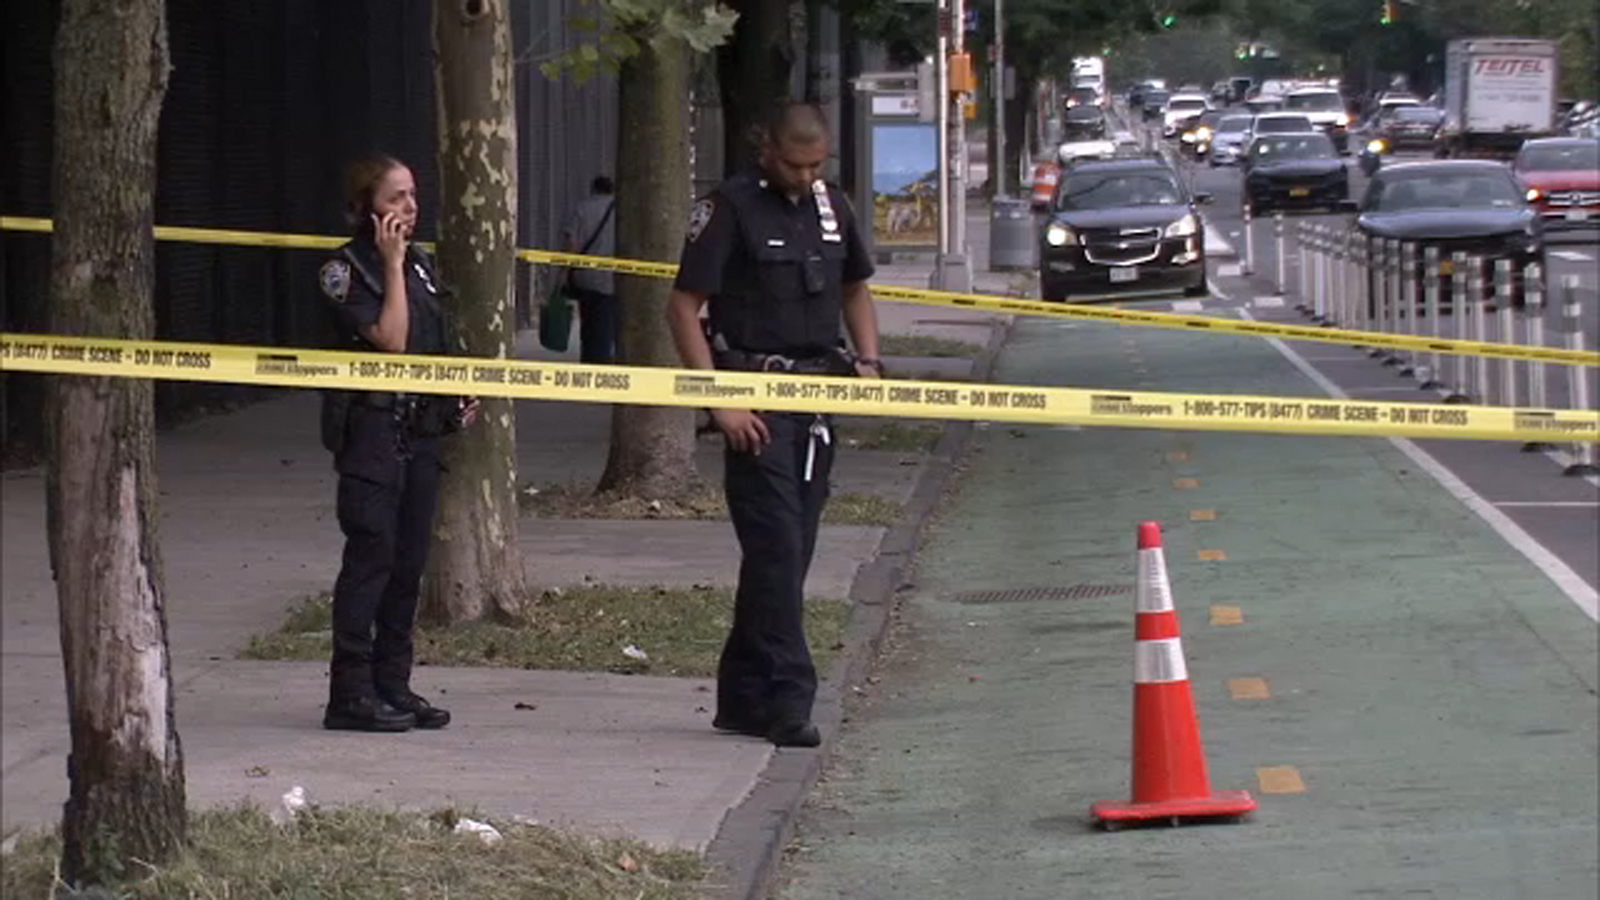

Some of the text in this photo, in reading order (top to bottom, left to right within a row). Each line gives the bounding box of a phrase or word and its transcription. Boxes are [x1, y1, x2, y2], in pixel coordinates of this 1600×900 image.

[1475, 60, 1544, 75] TEITEL
[12, 342, 47, 359] (8477)
[52, 344, 84, 360] CRIME
[88, 347, 121, 362] SCENE
[134, 349, 149, 364] DO
[152, 351, 172, 366] NOT
[176, 352, 210, 368] CROSS
[349, 361, 432, 379] 1-800-577-TIPS
[434, 364, 467, 383] (8477)
[472, 367, 505, 383] CRIME
[509, 370, 542, 386] SCENE
[555, 371, 569, 387] DO
[572, 372, 592, 388] NOT
[595, 373, 630, 390] CROSS
[767, 382, 848, 399] 1-800-577-TIPS
[850, 384, 884, 402] (8477)
[889, 387, 921, 403] CRIME
[925, 388, 957, 405] SCENE
[970, 391, 985, 406] DO
[988, 391, 1009, 407] NOT
[1012, 392, 1046, 408] CROSS
[1184, 400, 1266, 417] 1-800-577-TIPS
[1268, 402, 1303, 419] (8477)
[1307, 404, 1340, 420] CRIME
[1344, 406, 1378, 421] SCENE
[1390, 408, 1405, 423] DO
[1408, 409, 1429, 424] NOT
[1432, 409, 1468, 426] CROSS
